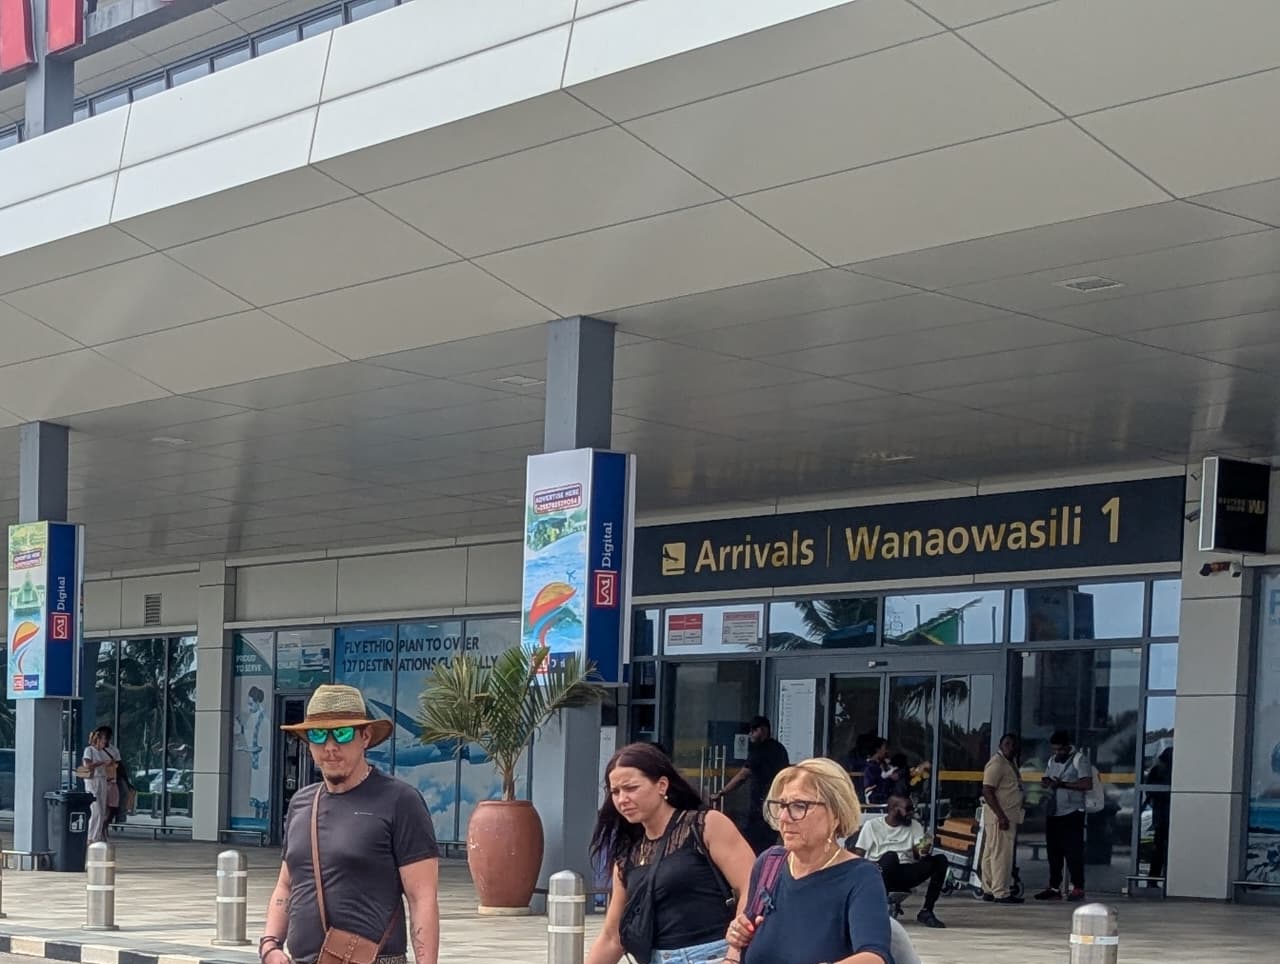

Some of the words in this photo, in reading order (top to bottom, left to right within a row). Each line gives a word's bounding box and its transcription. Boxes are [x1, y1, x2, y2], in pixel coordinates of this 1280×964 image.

[601, 522, 614, 568] Digital
[694, 530, 815, 573] Arrivals
[845, 505, 1082, 561] Wanaowasili
[1101, 496, 1121, 543] 1
[57, 576, 67, 611] Digital
[344, 641, 361, 654] FLY
[362, 638, 424, 654] ETHIOPIAN
[426, 637, 442, 652] TO
[443, 635, 479, 650] OVER
[342, 658, 358, 673] 127
[359, 656, 437, 672] DESTINATIONS
